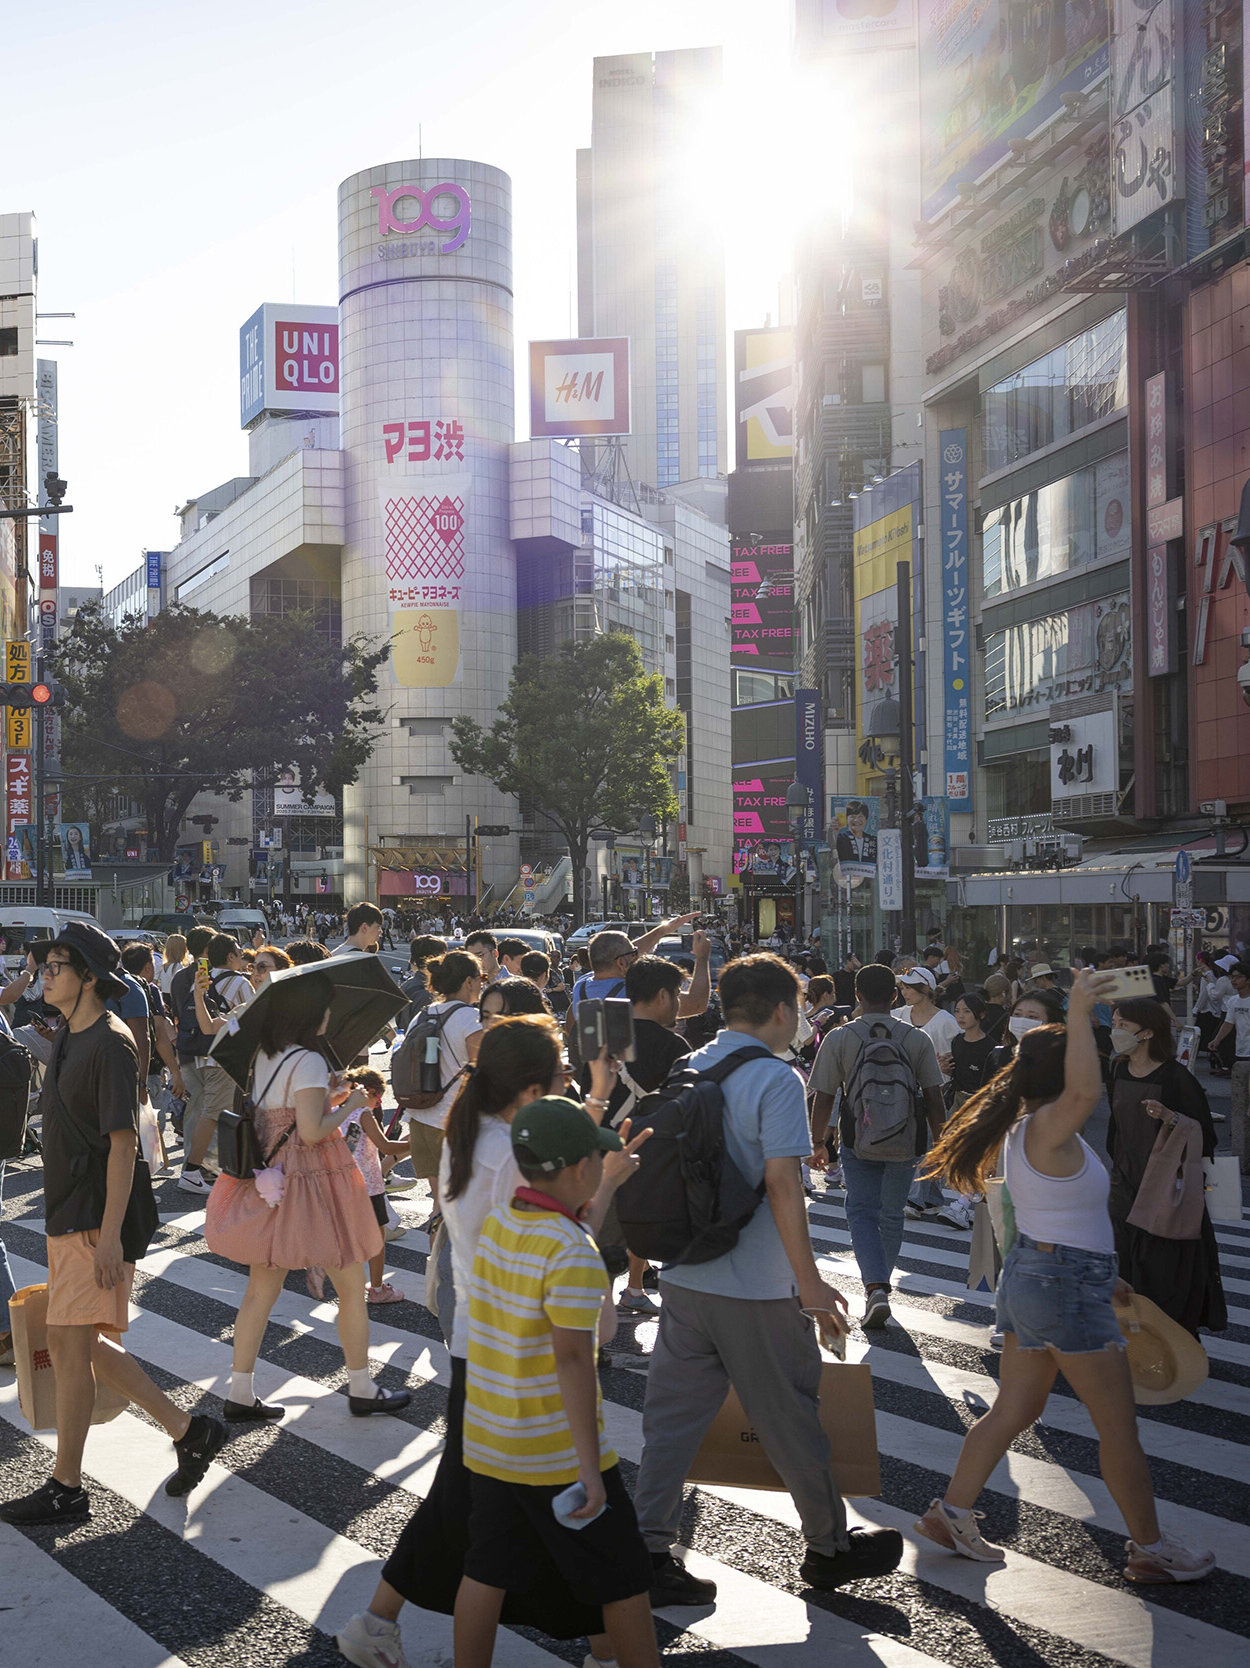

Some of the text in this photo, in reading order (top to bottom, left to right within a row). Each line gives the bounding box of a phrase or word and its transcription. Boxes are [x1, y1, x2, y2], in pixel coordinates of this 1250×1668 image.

[1116, 0, 1172, 199] んじゃ
[370, 182, 472, 253] 109
[244, 324, 259, 367] THE
[282, 330, 331, 354] UNI
[241, 362, 264, 411] PRIME
[283, 359, 335, 388] QLO
[555, 370, 604, 404] H&M
[382, 419, 465, 464] マヨ渋
[435, 514, 459, 531] 100
[42, 549, 55, 577] 免税
[734, 545, 790, 556] TAX FREE
[945, 471, 966, 672] サマーフルーツギフト
[389, 586, 462, 601] キューピー マヨネーズ
[735, 628, 792, 638] TAX FREE
[416, 656, 435, 665] 450g
[805, 702, 815, 750] MIZUHO
[737, 797, 761, 806] TAX
[882, 835, 894, 897] 文化村通り
[414, 875, 441, 894] 109
[33, 1348, 52, 1371] 無
